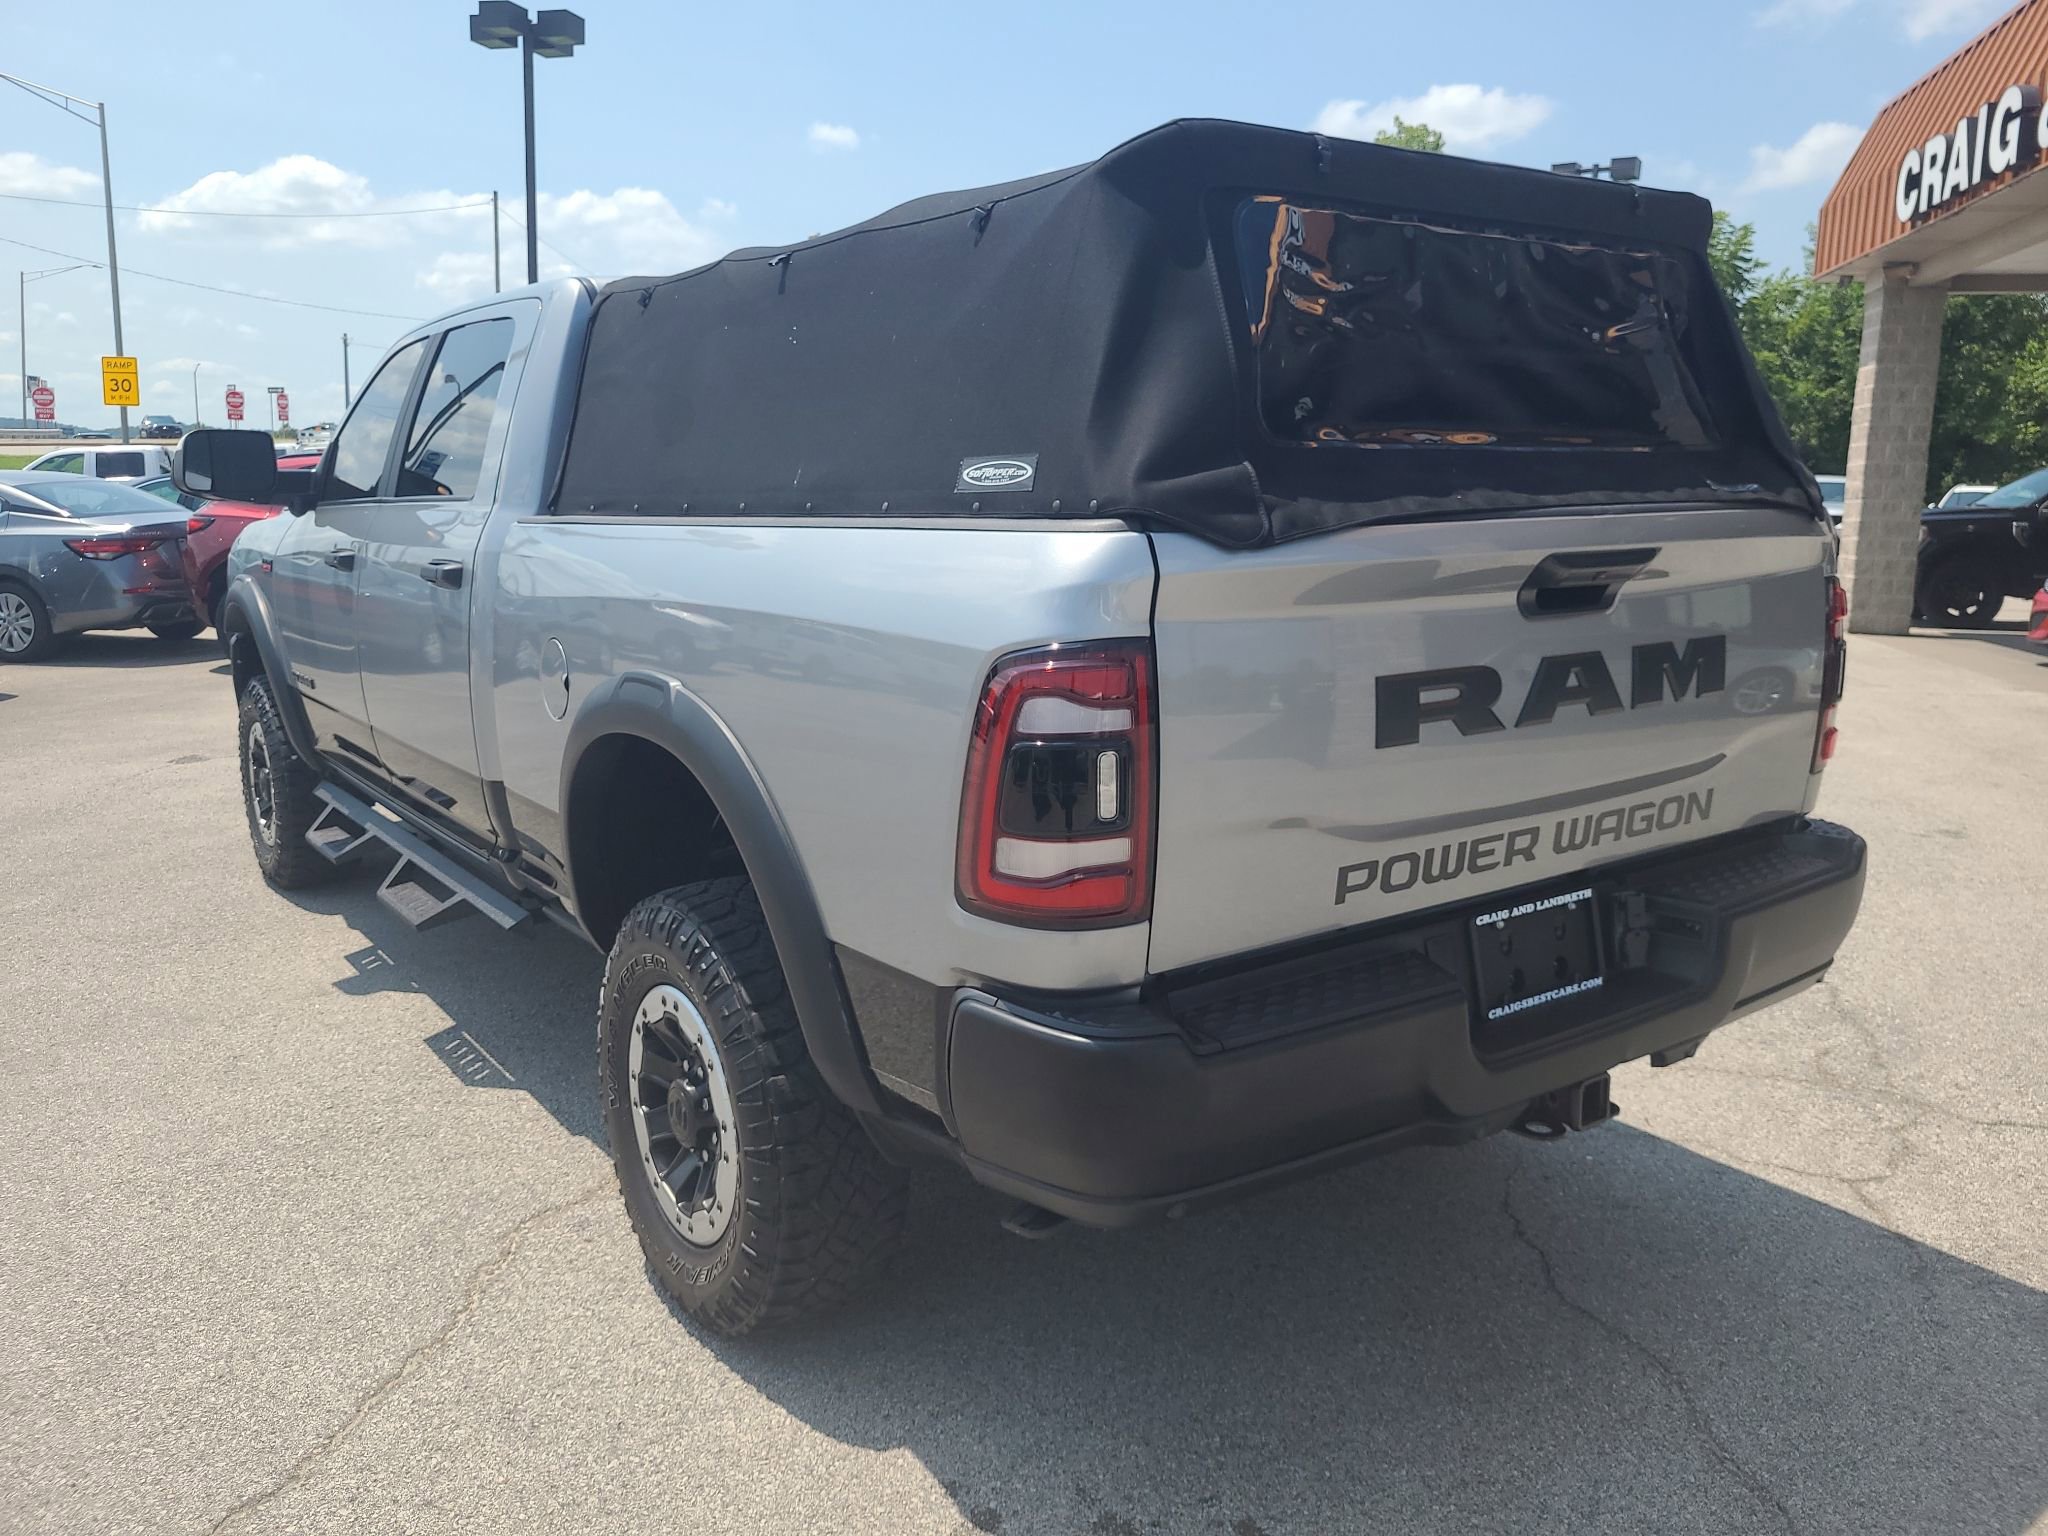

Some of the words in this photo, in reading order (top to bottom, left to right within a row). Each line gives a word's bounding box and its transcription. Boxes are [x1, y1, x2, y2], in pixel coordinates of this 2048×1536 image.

[1896, 84, 2023, 224] CRAIG
[106, 361, 133, 369] RAMP
[109, 378, 132, 393] 30
[1374, 634, 1727, 750] RAM
[1333, 825, 1540, 906] POWER
[1552, 787, 1715, 856] WAGON
[1475, 908, 1510, 926] CRAIG
[1511, 902, 1536, 917] AND
[1536, 888, 1593, 911] LANDRETH
[1488, 976, 1604, 1020] CRAIGSBESTCARS.COM
